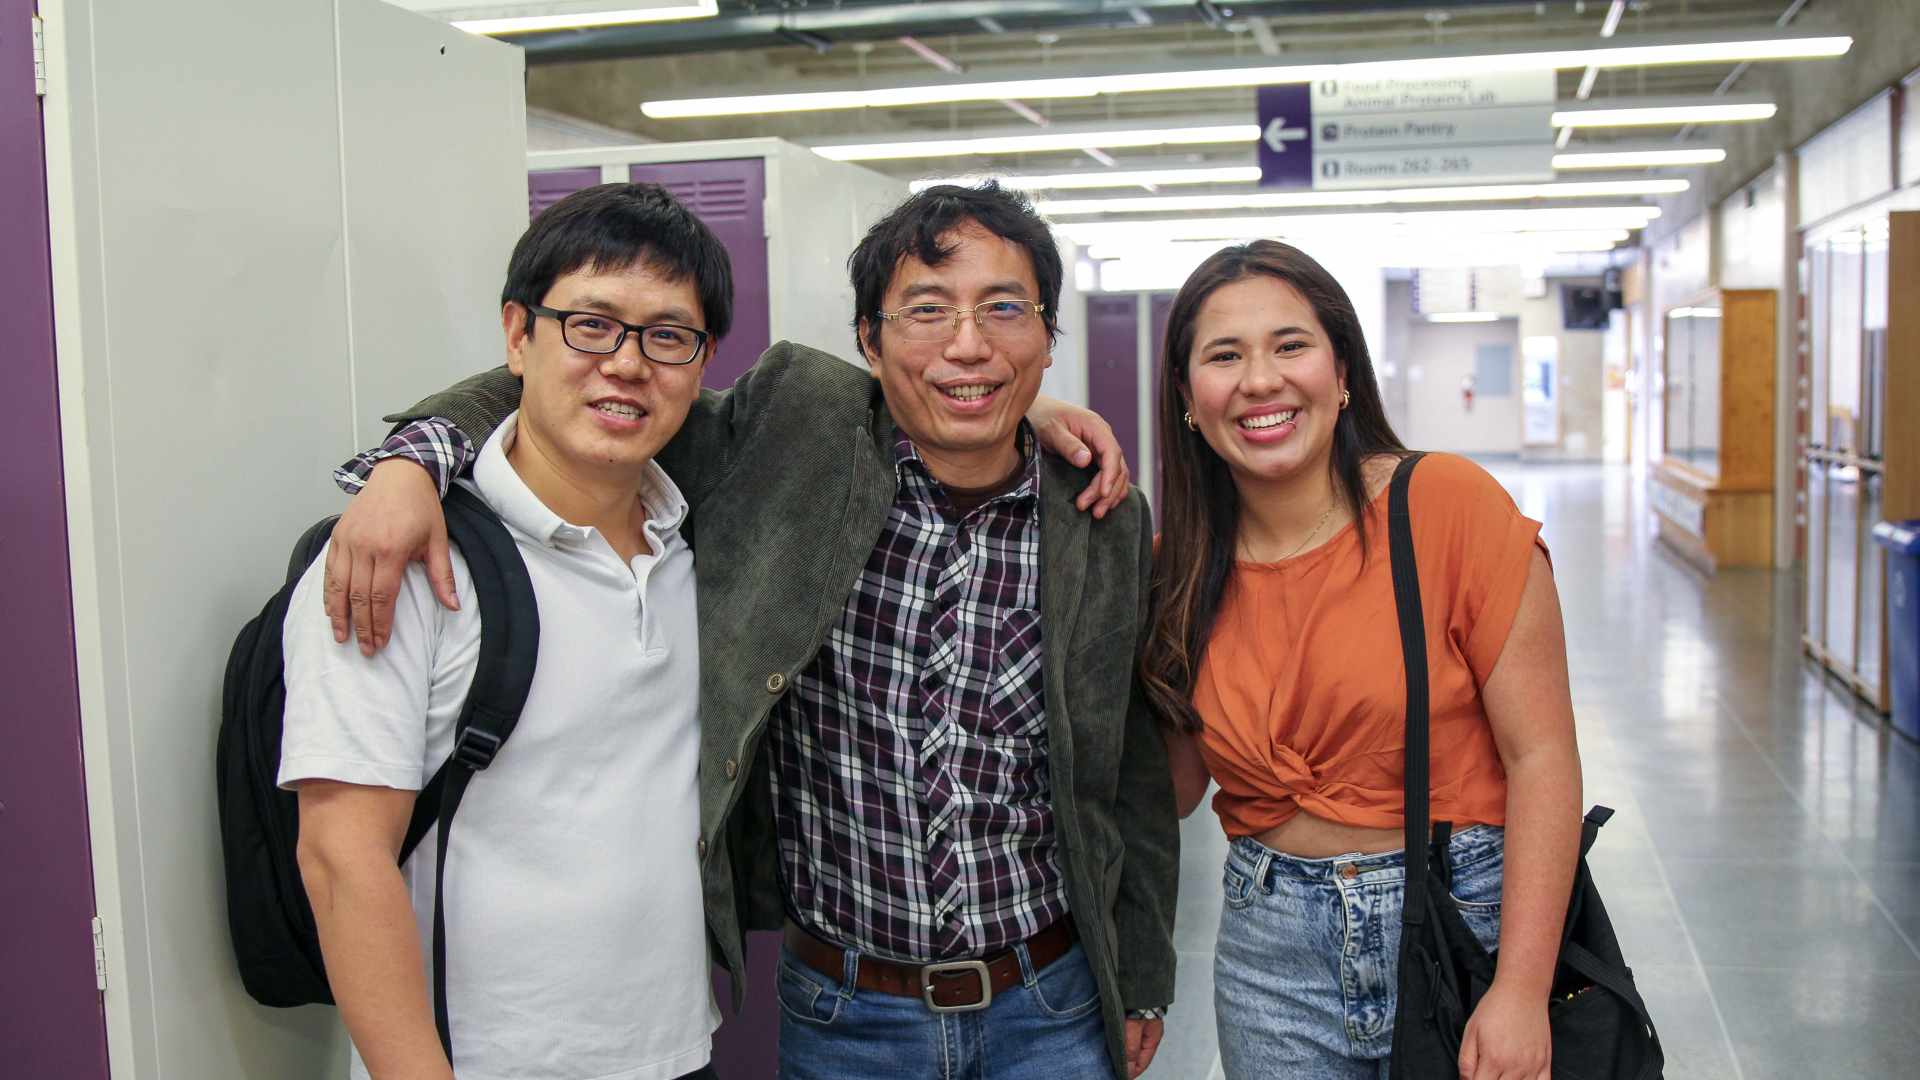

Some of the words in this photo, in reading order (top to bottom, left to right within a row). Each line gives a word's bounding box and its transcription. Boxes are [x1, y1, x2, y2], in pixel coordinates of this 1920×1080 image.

[1344, 122, 1400, 138] Protein
[1404, 120, 1457, 138] Pantry
[1345, 160, 1396, 174] Rooms
